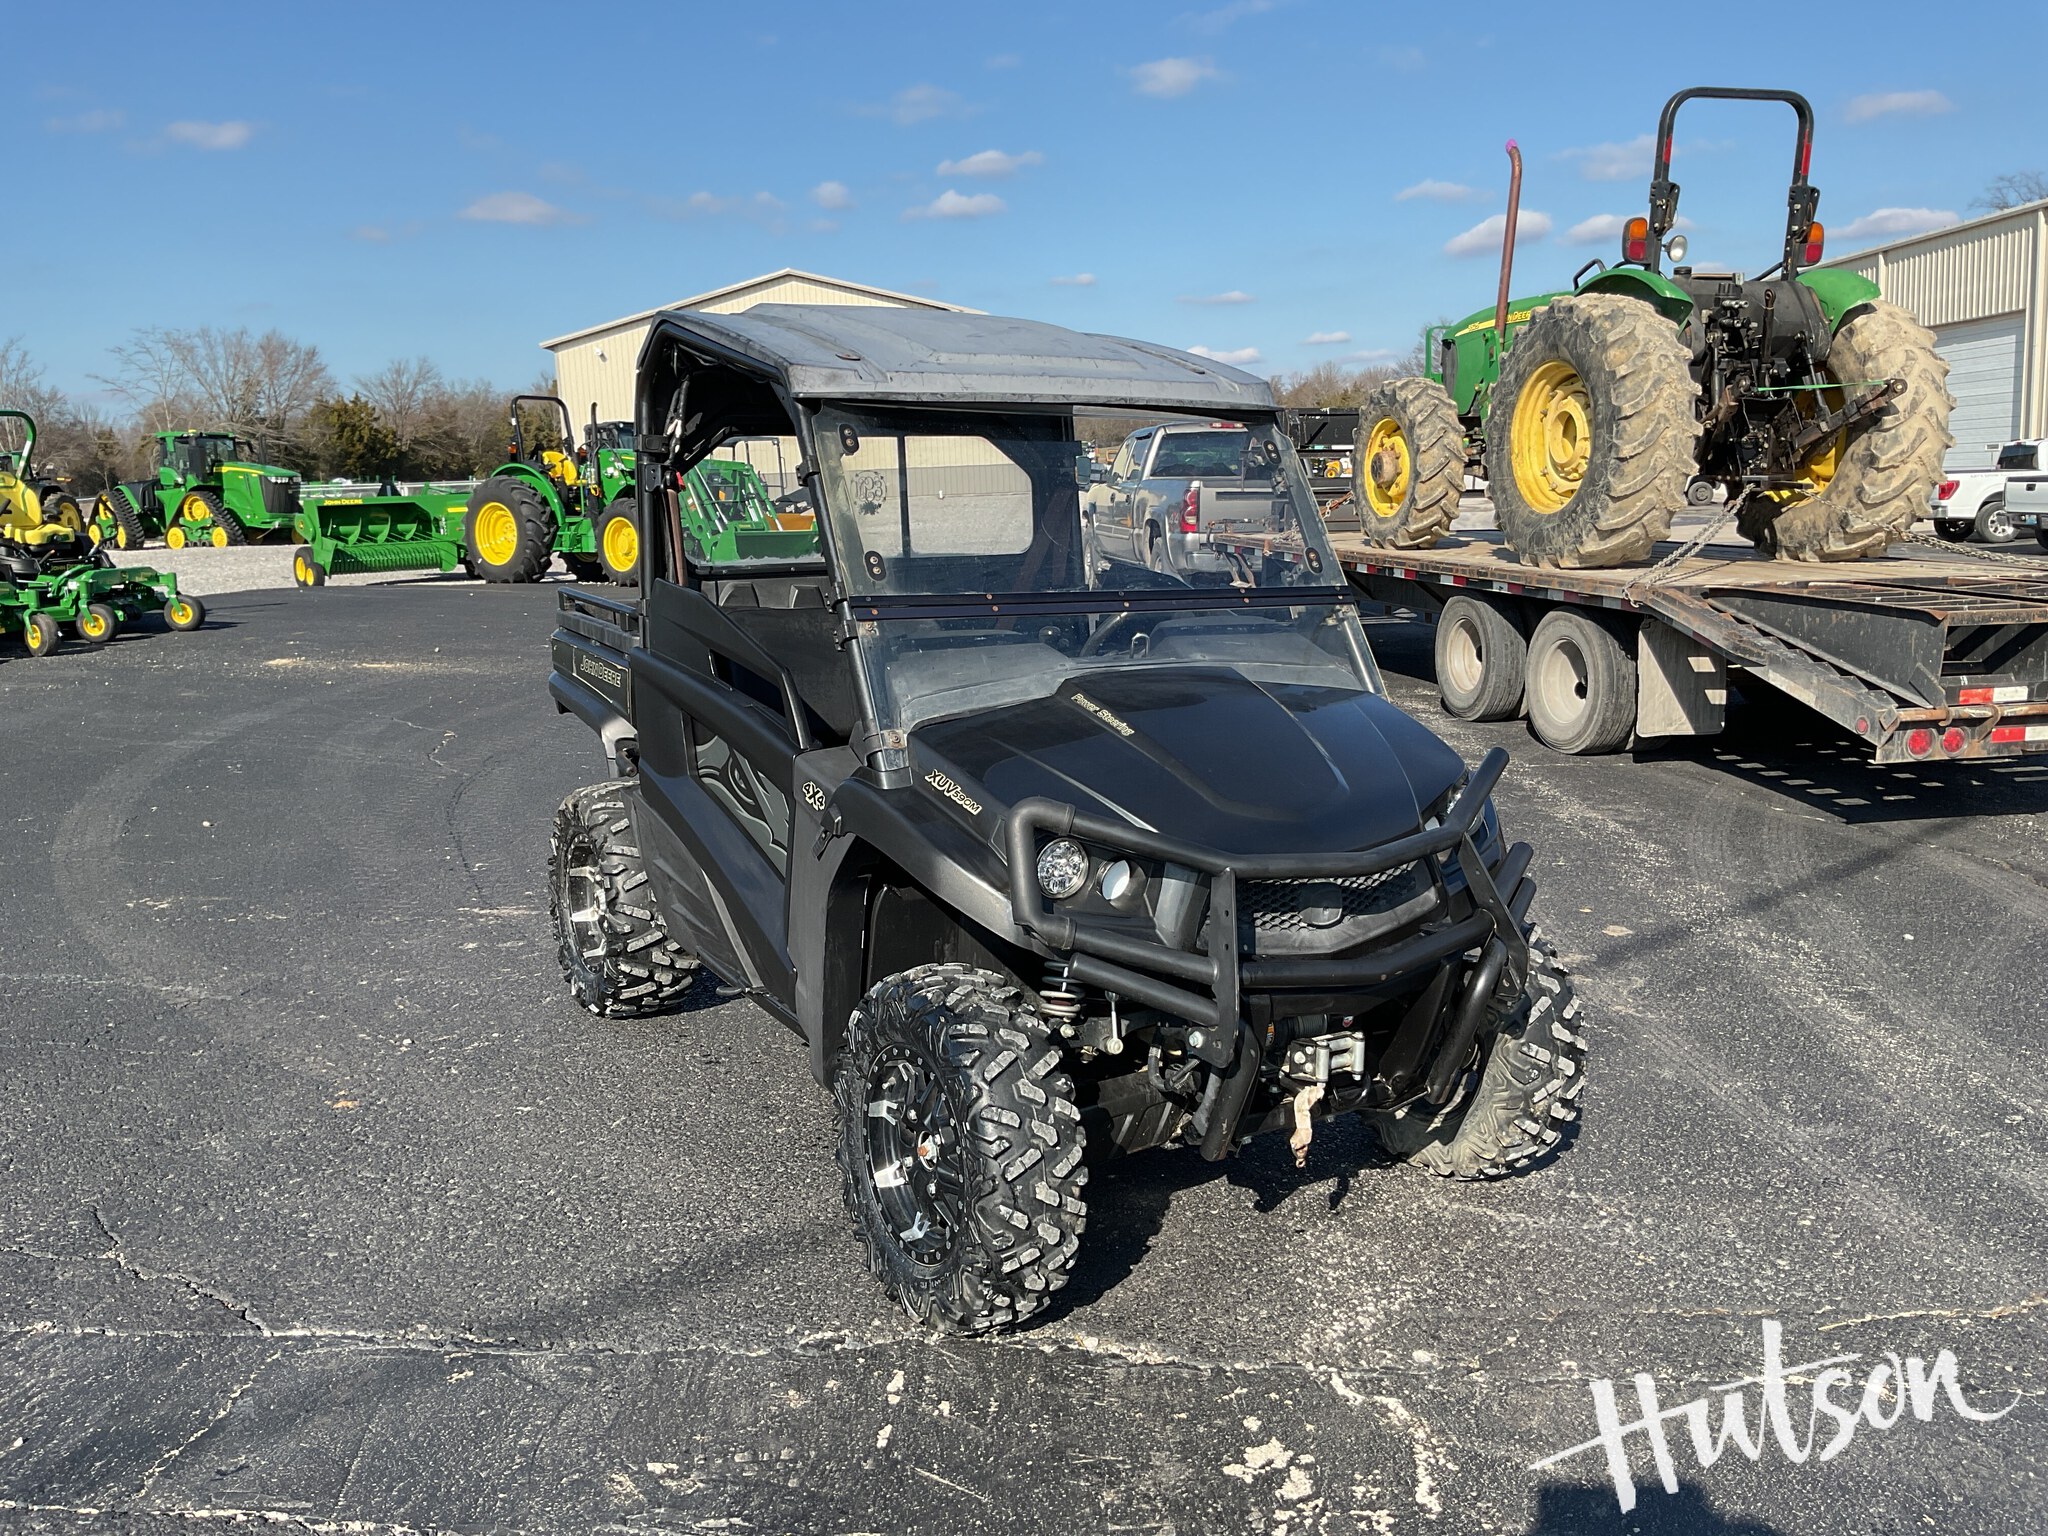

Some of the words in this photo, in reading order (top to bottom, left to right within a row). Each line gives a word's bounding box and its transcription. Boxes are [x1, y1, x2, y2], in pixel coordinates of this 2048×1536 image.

[1513, 310, 1531, 321] DEER
[580, 655, 599, 677] JOHN
[598, 662, 621, 687] DEERE
[1070, 693, 1100, 712] Power
[1096, 709, 1135, 736] Steering
[802, 781, 826, 811] 4X4
